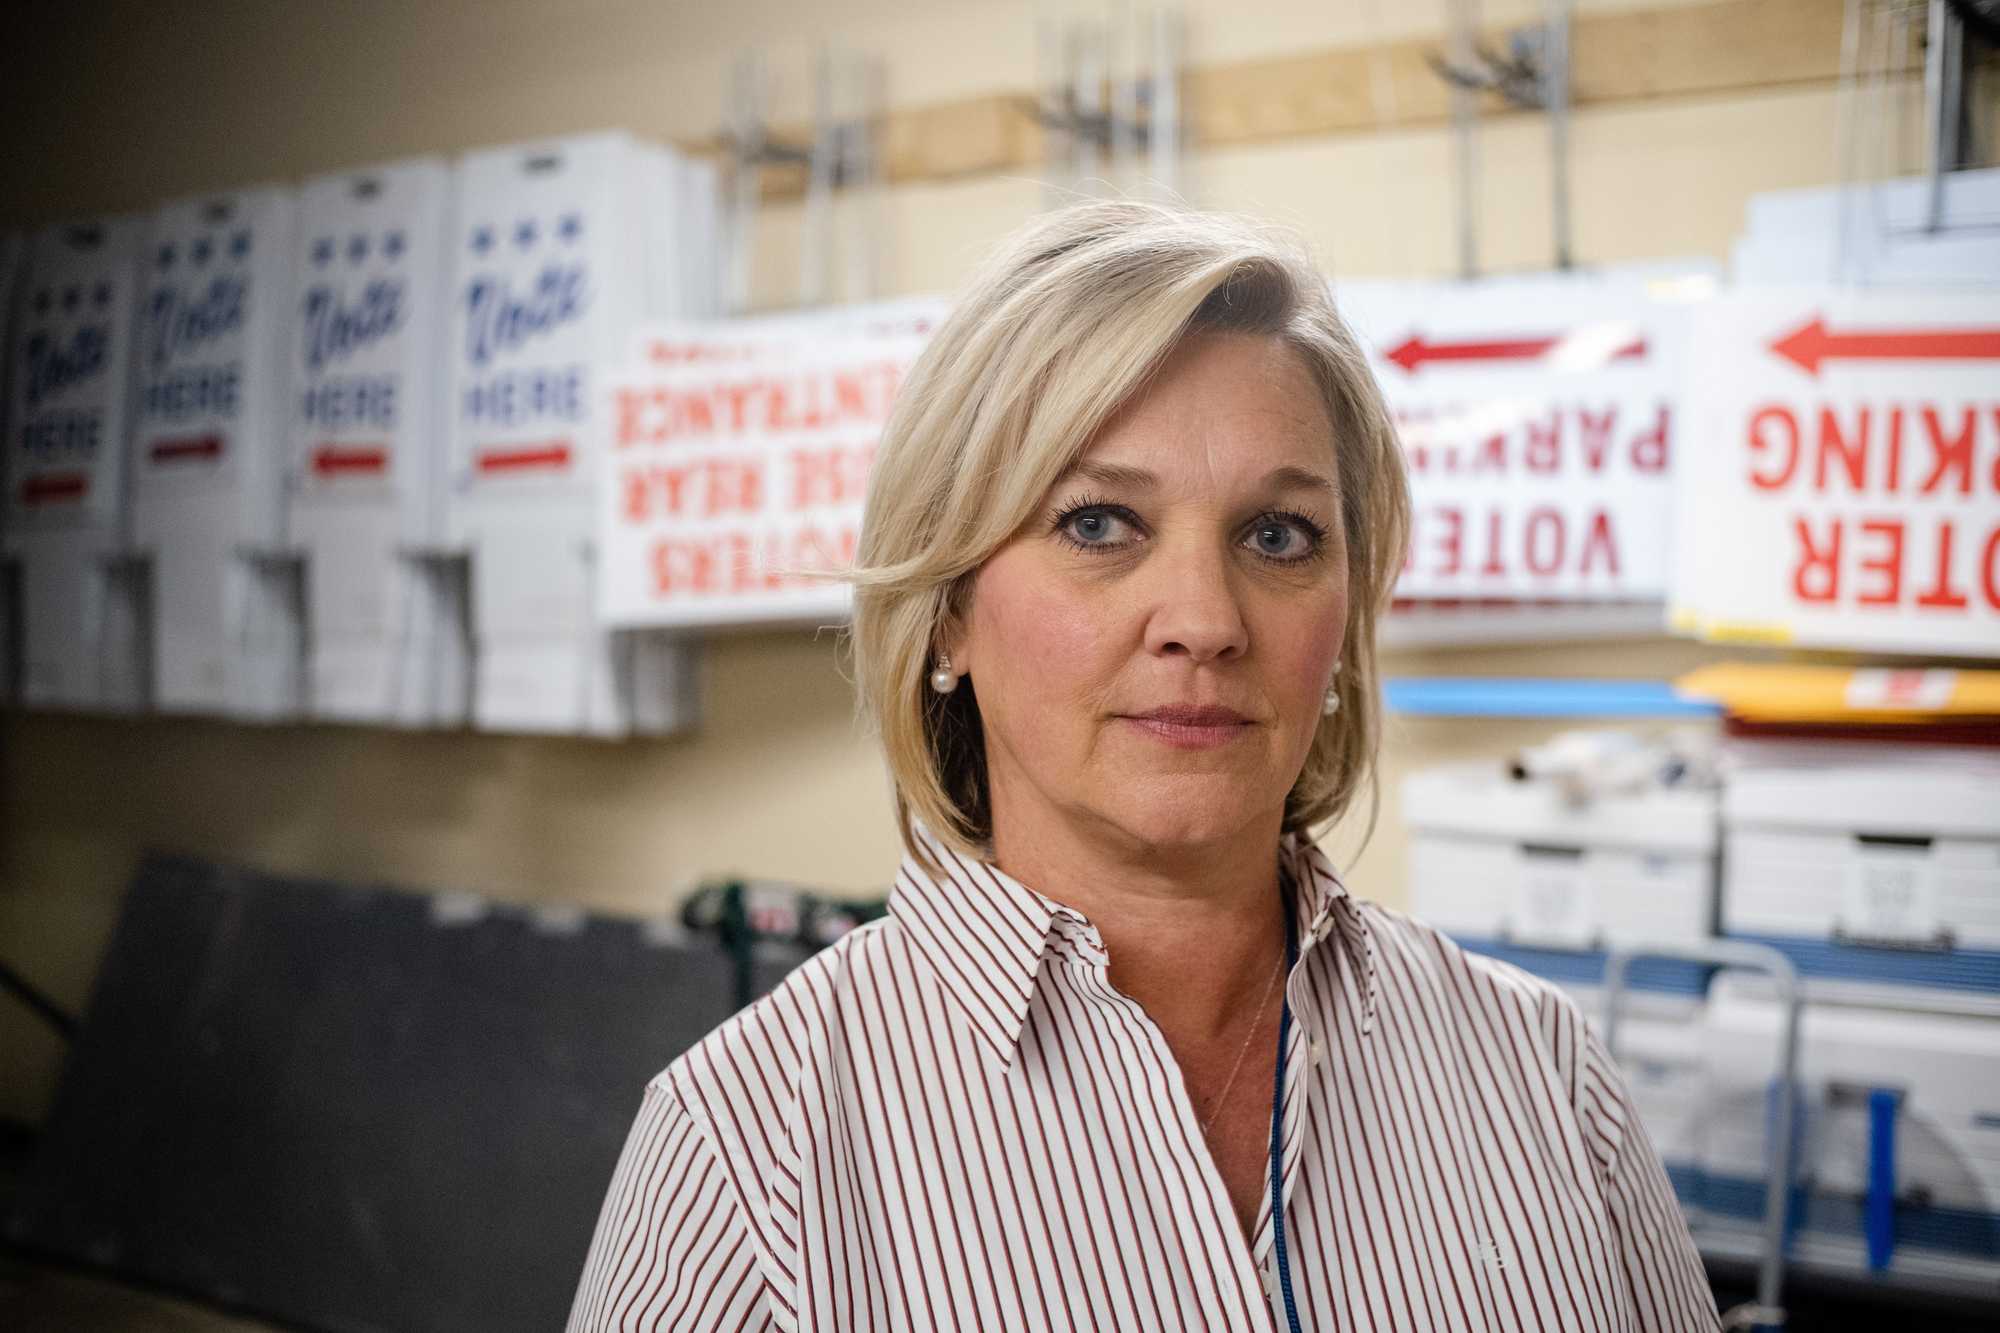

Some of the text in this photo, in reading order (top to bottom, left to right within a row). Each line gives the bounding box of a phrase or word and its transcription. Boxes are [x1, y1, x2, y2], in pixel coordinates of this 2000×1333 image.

[466, 263, 584, 366] Vote
[304, 376, 401, 428] HERE
[466, 367, 586, 424] HERE
[1749, 402, 2000, 494] KING
[1402, 504, 1624, 577] VOTE
